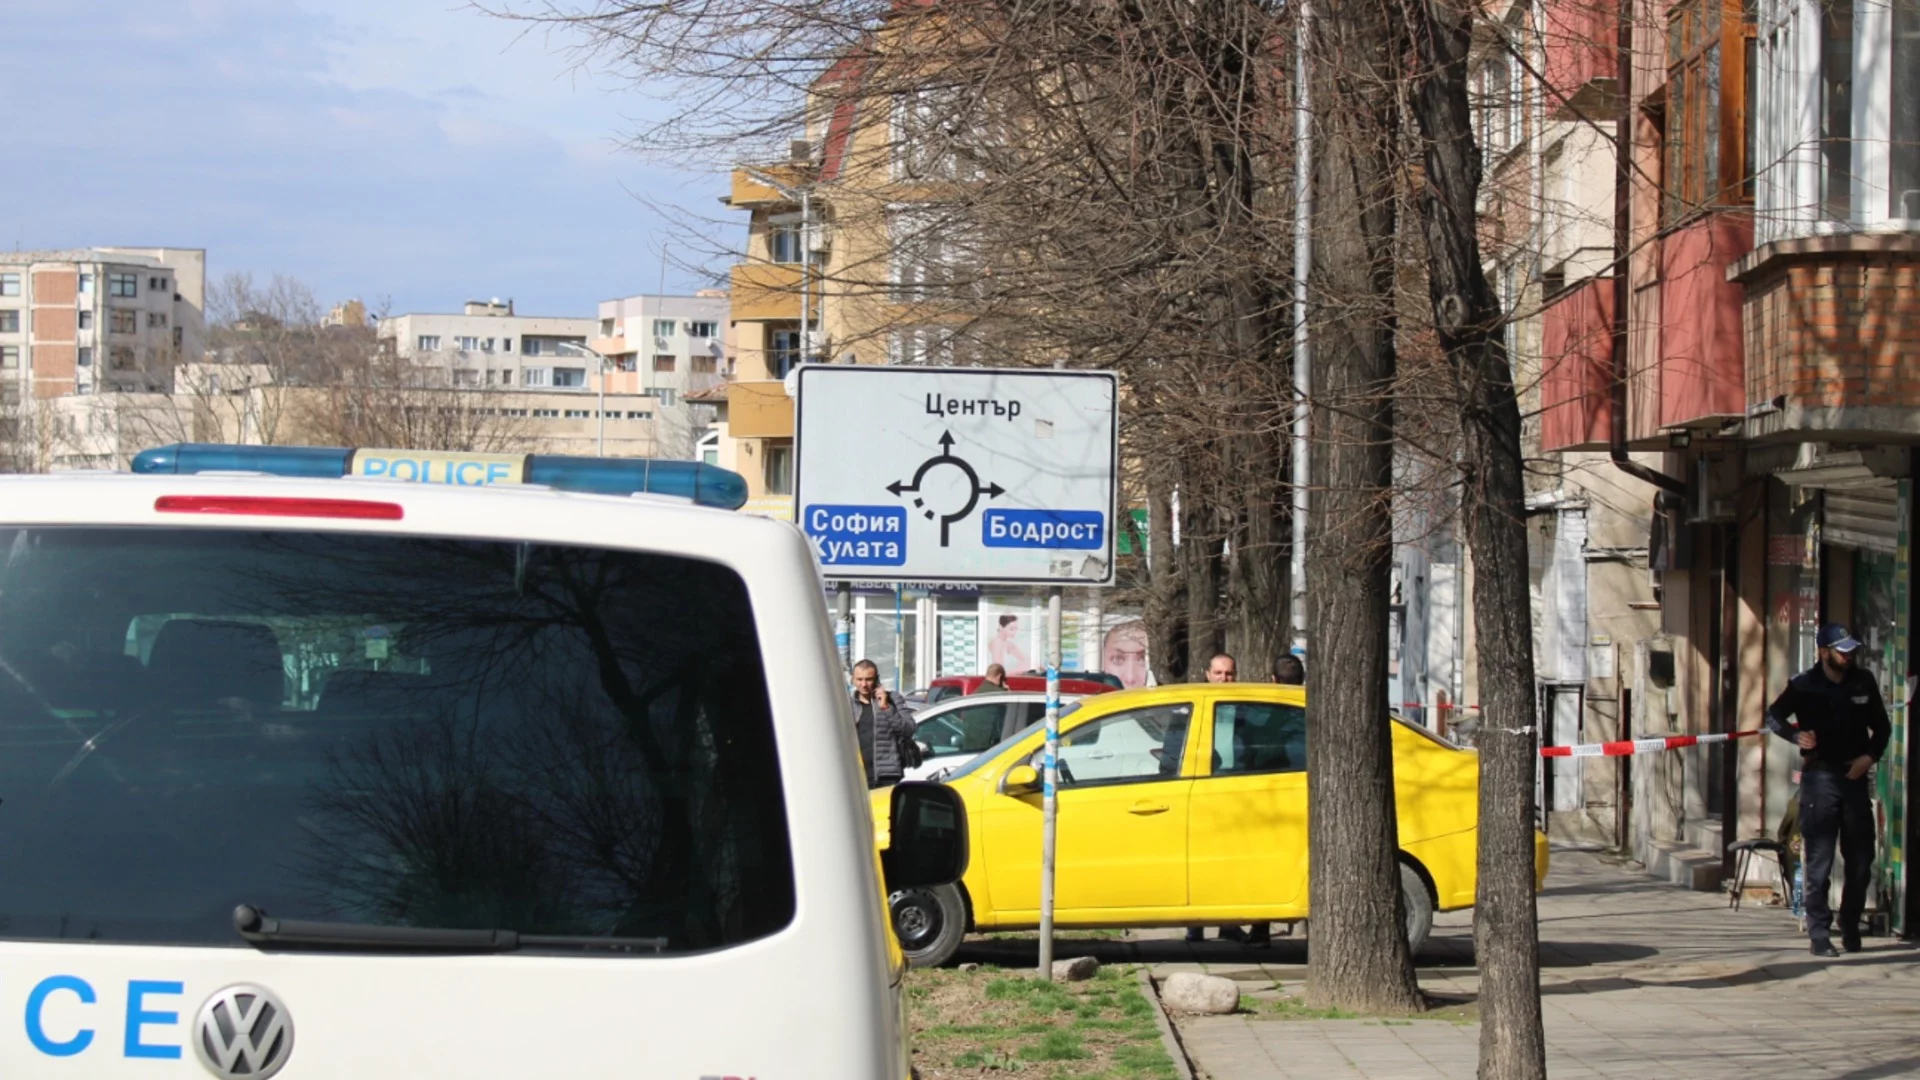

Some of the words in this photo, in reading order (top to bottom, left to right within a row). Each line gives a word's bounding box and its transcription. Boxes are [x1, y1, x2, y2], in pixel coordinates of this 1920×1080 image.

[925, 393, 1021, 421] Център
[363, 458, 512, 486] POLICE
[812, 509, 900, 535] София
[990, 515, 1099, 544] Бодрост
[812, 535, 899, 563] Кулата
